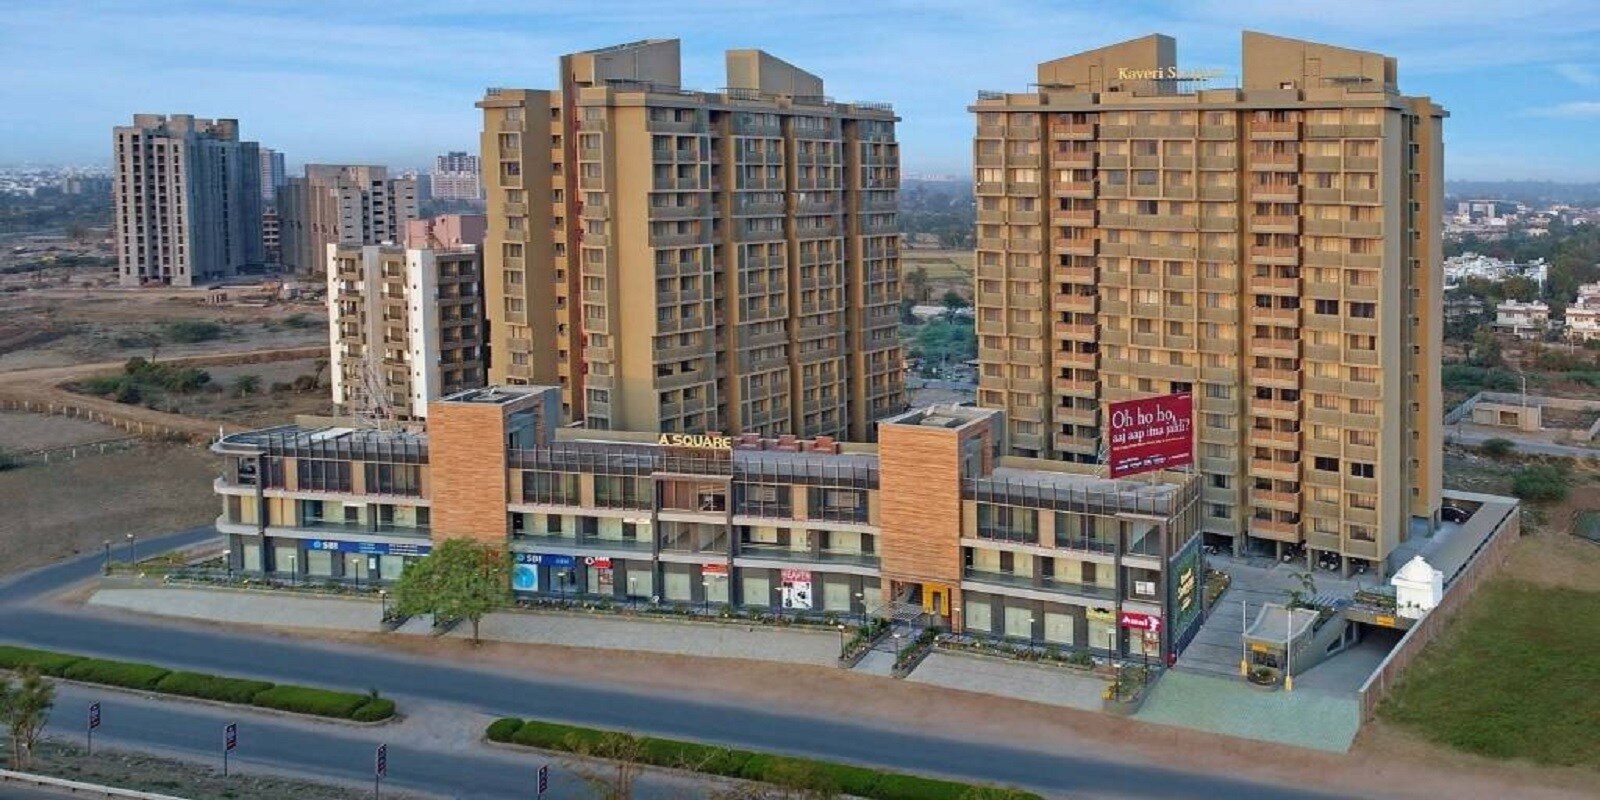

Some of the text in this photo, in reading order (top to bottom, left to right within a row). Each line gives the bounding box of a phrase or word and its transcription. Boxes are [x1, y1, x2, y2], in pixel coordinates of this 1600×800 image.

[1118, 67, 1163, 80] Kaveri
[1112, 411, 1134, 429] Oh
[1137, 406, 1153, 425] ho
[658, 433, 731, 448] A SQUARE
[1127, 431, 1145, 442] aap
[526, 554, 541, 564] SBI
